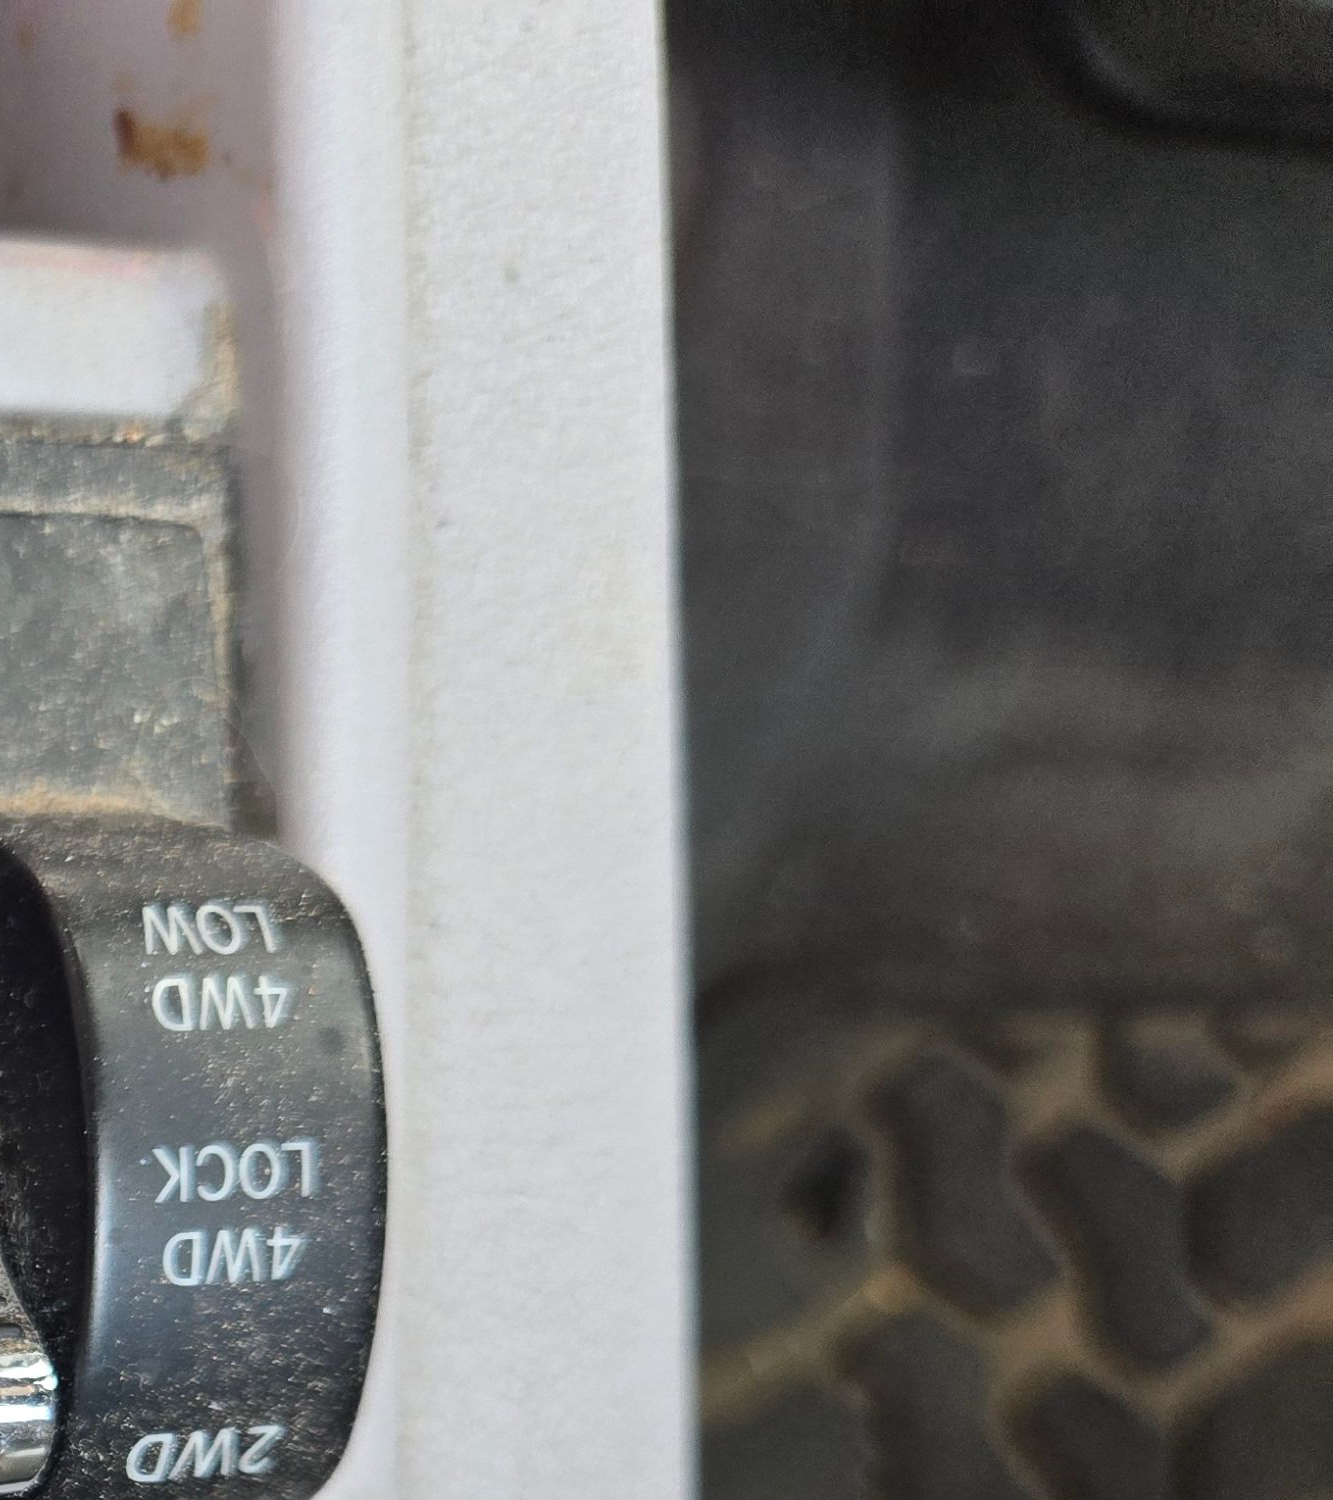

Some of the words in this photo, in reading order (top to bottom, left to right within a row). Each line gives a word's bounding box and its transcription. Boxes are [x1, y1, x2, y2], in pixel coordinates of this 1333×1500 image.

[141, 902, 278, 955] LOW
[151, 974, 290, 1032] 4WD
[151, 1140, 319, 1203] LOCK
[162, 1227, 303, 1287] 4WD
[125, 1424, 284, 1484] 2WD
